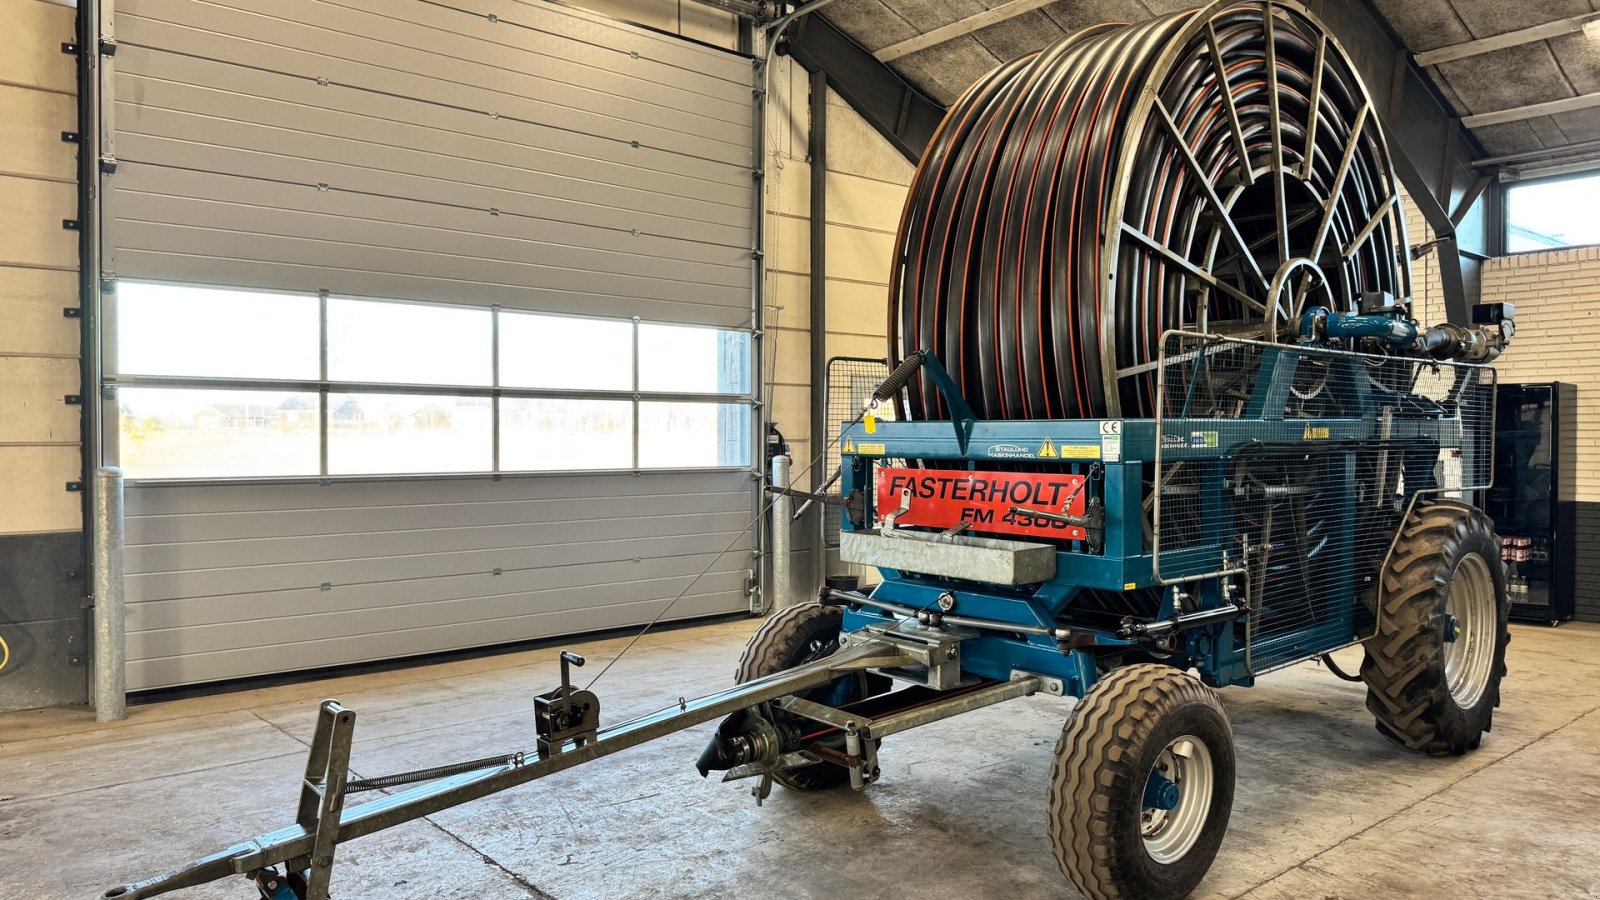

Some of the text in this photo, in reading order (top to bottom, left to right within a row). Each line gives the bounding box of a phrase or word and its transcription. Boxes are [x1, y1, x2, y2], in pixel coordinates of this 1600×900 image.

[1103, 421, 1118, 433] CE
[889, 475, 1068, 506] FASTERHOLT
[961, 507, 994, 524] FM
